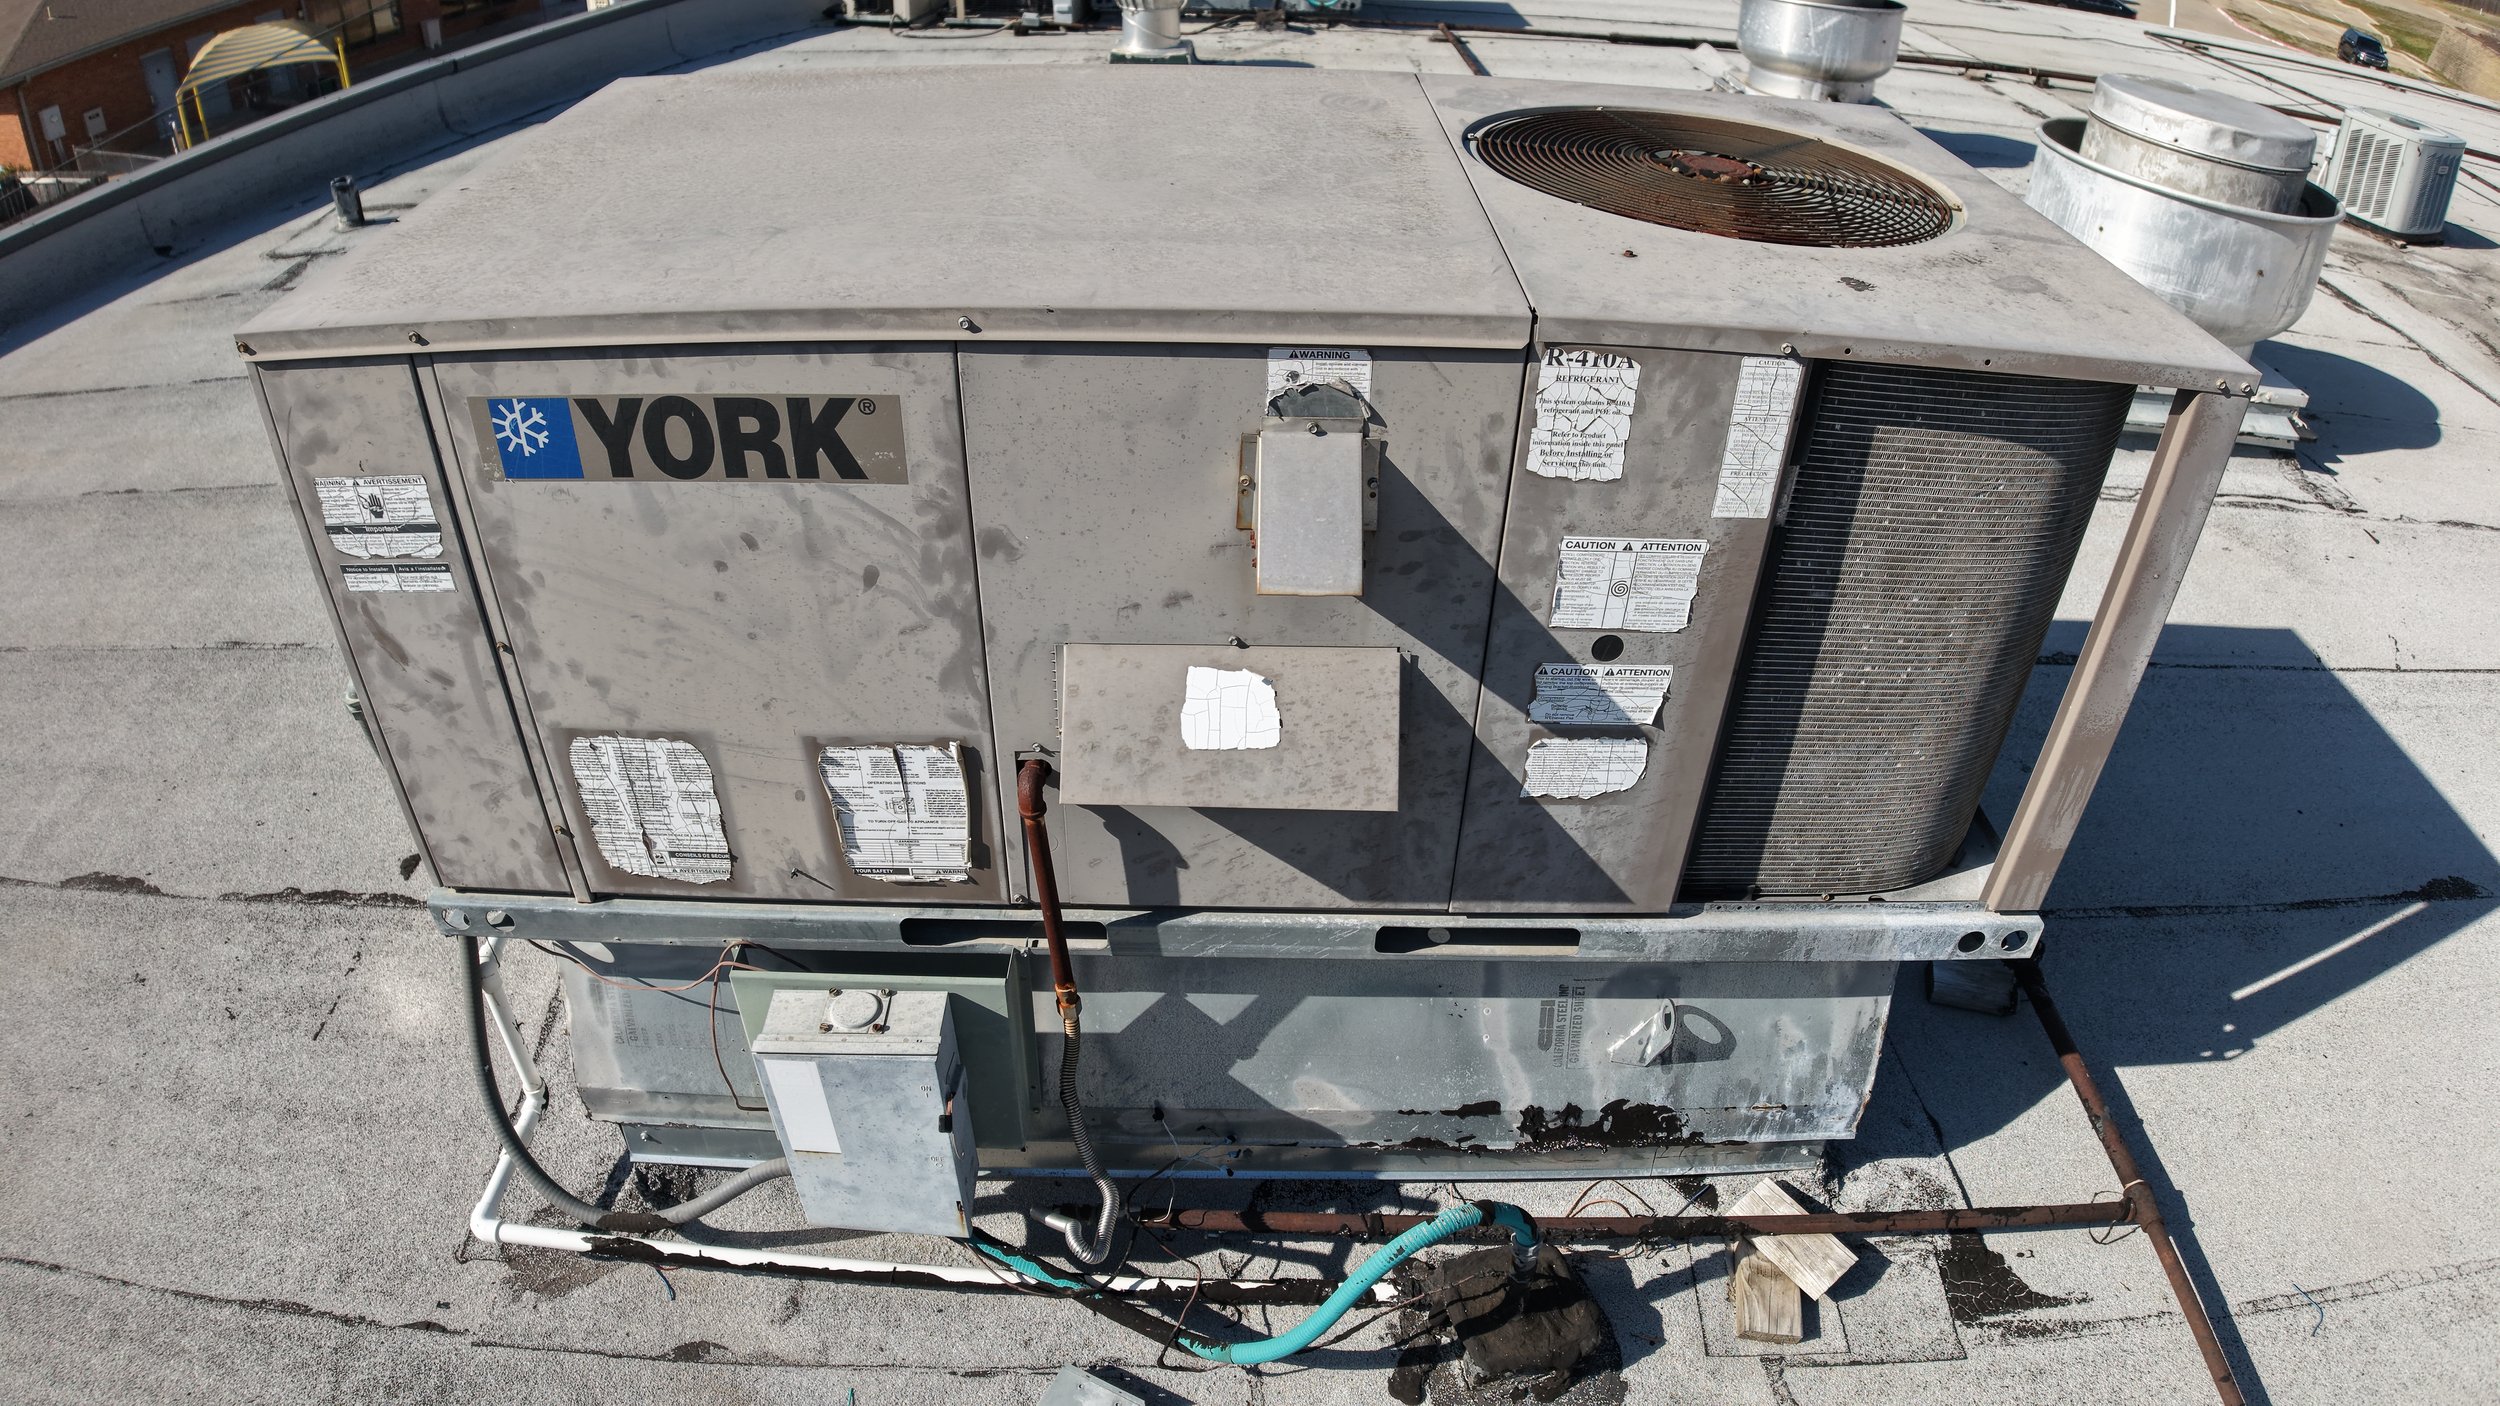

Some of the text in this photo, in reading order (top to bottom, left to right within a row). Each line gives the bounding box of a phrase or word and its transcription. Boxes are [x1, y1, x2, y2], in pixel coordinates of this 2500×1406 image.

[1299, 351, 1350, 359] WARNING
[1546, 347, 1634, 368] R-410A
[1557, 375, 1620, 383] REFRIGERANT
[1566, 450, 1603, 458] Installing
[1542, 459, 1577, 468] Servicing
[363, 477, 422, 486] AVERTISSEMENT
[365, 526, 399, 534] Important
[1566, 541, 1702, 552] CAUTION ATTENTION
[1550, 668, 1598, 676] CAUTION
[1557, 998, 1568, 1022] STEEL
[622, 992, 639, 1042] GALVANIZED
[1569, 1015, 1582, 1063] GALVANIZED
[1552, 1024, 1567, 1068] CALIFORNIA
